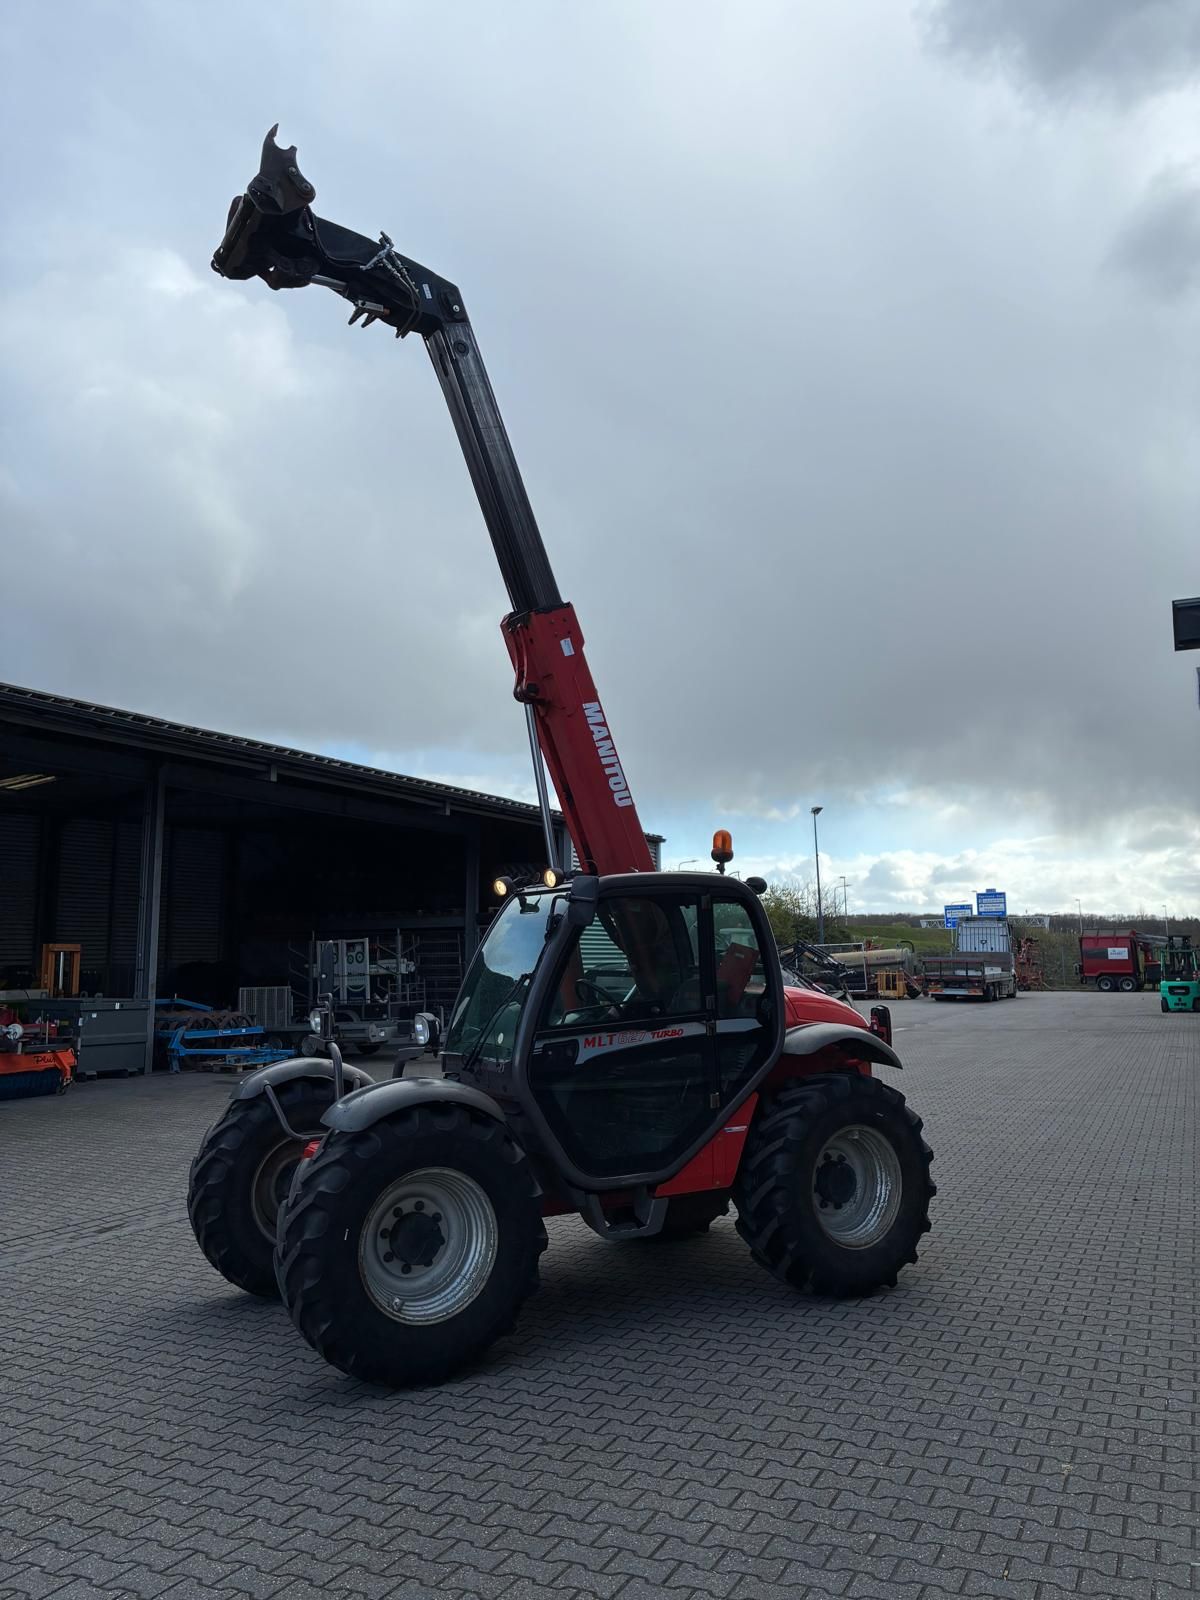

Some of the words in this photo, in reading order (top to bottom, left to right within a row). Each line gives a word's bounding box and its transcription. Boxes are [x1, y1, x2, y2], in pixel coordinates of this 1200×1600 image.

[582, 701, 633, 808] MANITOU
[583, 1033, 617, 1049] MLT
[617, 1031, 647, 1045] 627
[650, 1028, 684, 1040] TURBO
